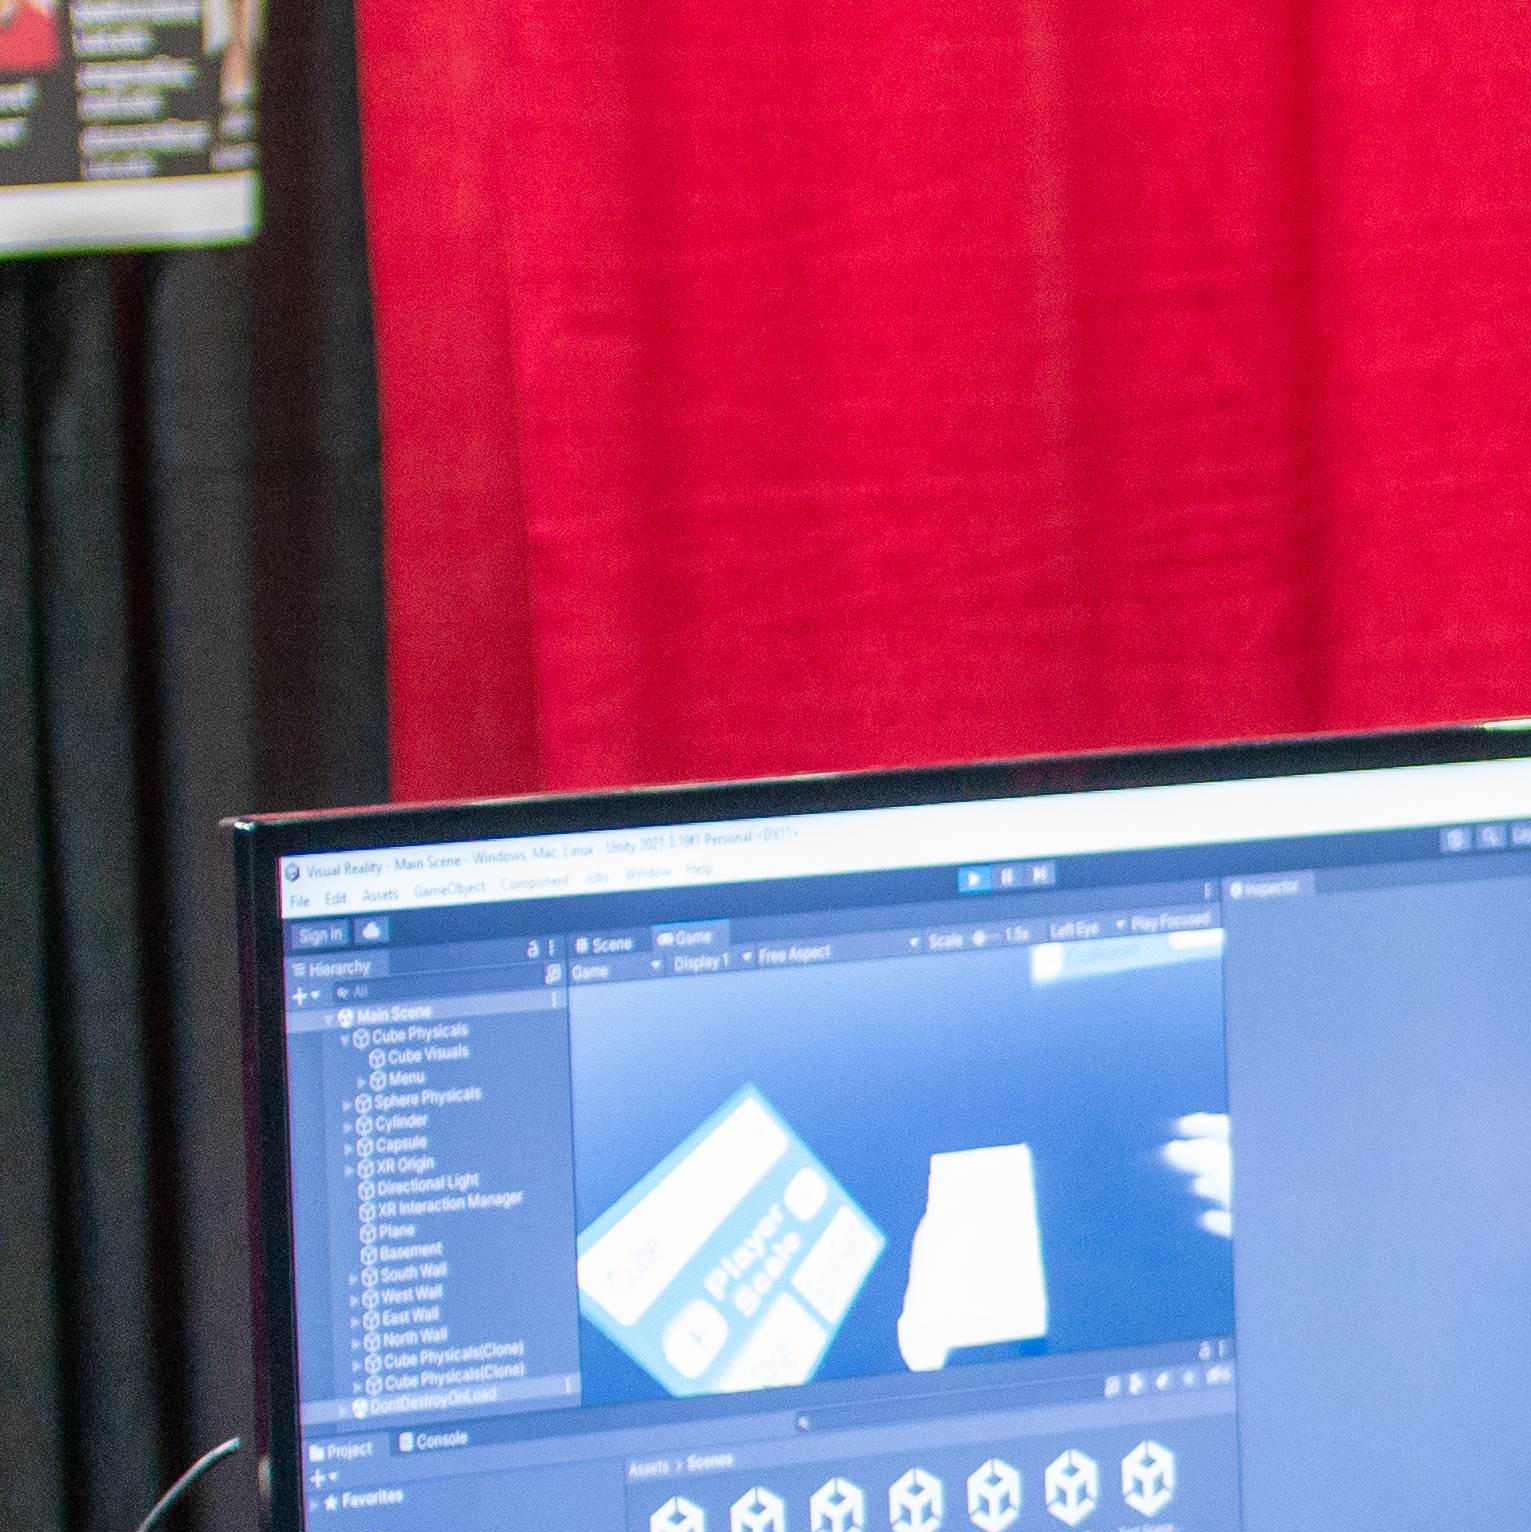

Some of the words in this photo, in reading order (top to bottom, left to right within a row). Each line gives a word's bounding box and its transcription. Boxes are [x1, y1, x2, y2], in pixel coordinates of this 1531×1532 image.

[306, 865, 341, 878] Visual
[344, 861, 382, 876] Reality
[394, 858, 423, 871] Main
[426, 855, 461, 869] Scene
[472, 849, 528, 865] Windows,
[532, 846, 559, 860] Mac,
[563, 844, 594, 858] Linux
[606, 841, 637, 855] Unity
[704, 831, 752, 846] Personal
[756, 827, 799, 841] <DX11>
[290, 894, 310, 908] File
[325, 892, 347, 905] Edit
[362, 889, 399, 902] Assets
[413, 881, 486, 899] GameObject
[501, 874, 569, 892] Component
[625, 867, 671, 880] Window
[686, 863, 713, 877] Help
[1050, 921, 1075, 940] Left
[1076, 919, 1101, 938] Eye
[1130, 914, 1158, 933] Play
[1160, 910, 1211, 929] Focused
[300, 928, 327, 946] Sign
[592, 936, 633, 953] Scene
[676, 930, 713, 946] Game
[928, 932, 963, 951] Scale
[674, 954, 719, 973] Display
[758, 948, 786, 965] Free
[789, 944, 832, 962] Aspect
[308, 959, 371, 978] Hierarchy
[571, 964, 610, 981] Game
[353, 985, 368, 998] All
[356, 1009, 389, 1025] Main
[391, 1005, 432, 1020] Scene
[372, 1028, 406, 1044] Cube
[408, 1022, 469, 1041] Physicals
[388, 1049, 423, 1064] Cube
[424, 1044, 469, 1061] Visuals
[389, 1071, 426, 1085] Menu
[374, 1093, 419, 1111] Sphere
[421, 1086, 482, 1106] Physicals
[375, 1113, 428, 1133] Cylinder
[375, 1135, 428, 1154] Capsule
[376, 1159, 396, 1174] XR
[397, 1156, 435, 1174] Origin
[377, 1176, 445, 1196] Directional
[447, 1173, 479, 1192] Light
[378, 1202, 397, 1217] XR
[398, 1197, 466, 1215] Interaction
[467, 1190, 524, 1209] Manager
[378, 1224, 416, 1239] Plane
[380, 1242, 443, 1261] Basement
[704, 1203, 783, 1301] Player
[380, 1266, 418, 1283] South
[419, 1262, 448, 1278] Wall
[731, 1231, 801, 1318] Scale
[381, 1288, 413, 1304] West
[415, 1284, 443, 1300] Wall
[382, 1310, 410, 1327] East
[412, 1306, 440, 1322] Wall
[382, 1329, 419, 1347] North
[419, 1326, 448, 1343] Wall
[383, 1352, 418, 1369] Cube
[420, 1339, 525, 1366] Physicals(Clone)
[384, 1373, 419, 1390] Cube
[420, 1361, 525, 1388] Physicals(Clone)
[370, 1386, 497, 1415] DontDestroyOnLoad
[416, 1430, 469, 1450] Console
[327, 1441, 372, 1460] Project
[628, 1460, 670, 1478] Assets
[687, 1453, 734, 1471] Scenes
[342, 1488, 404, 1509] Favorites
